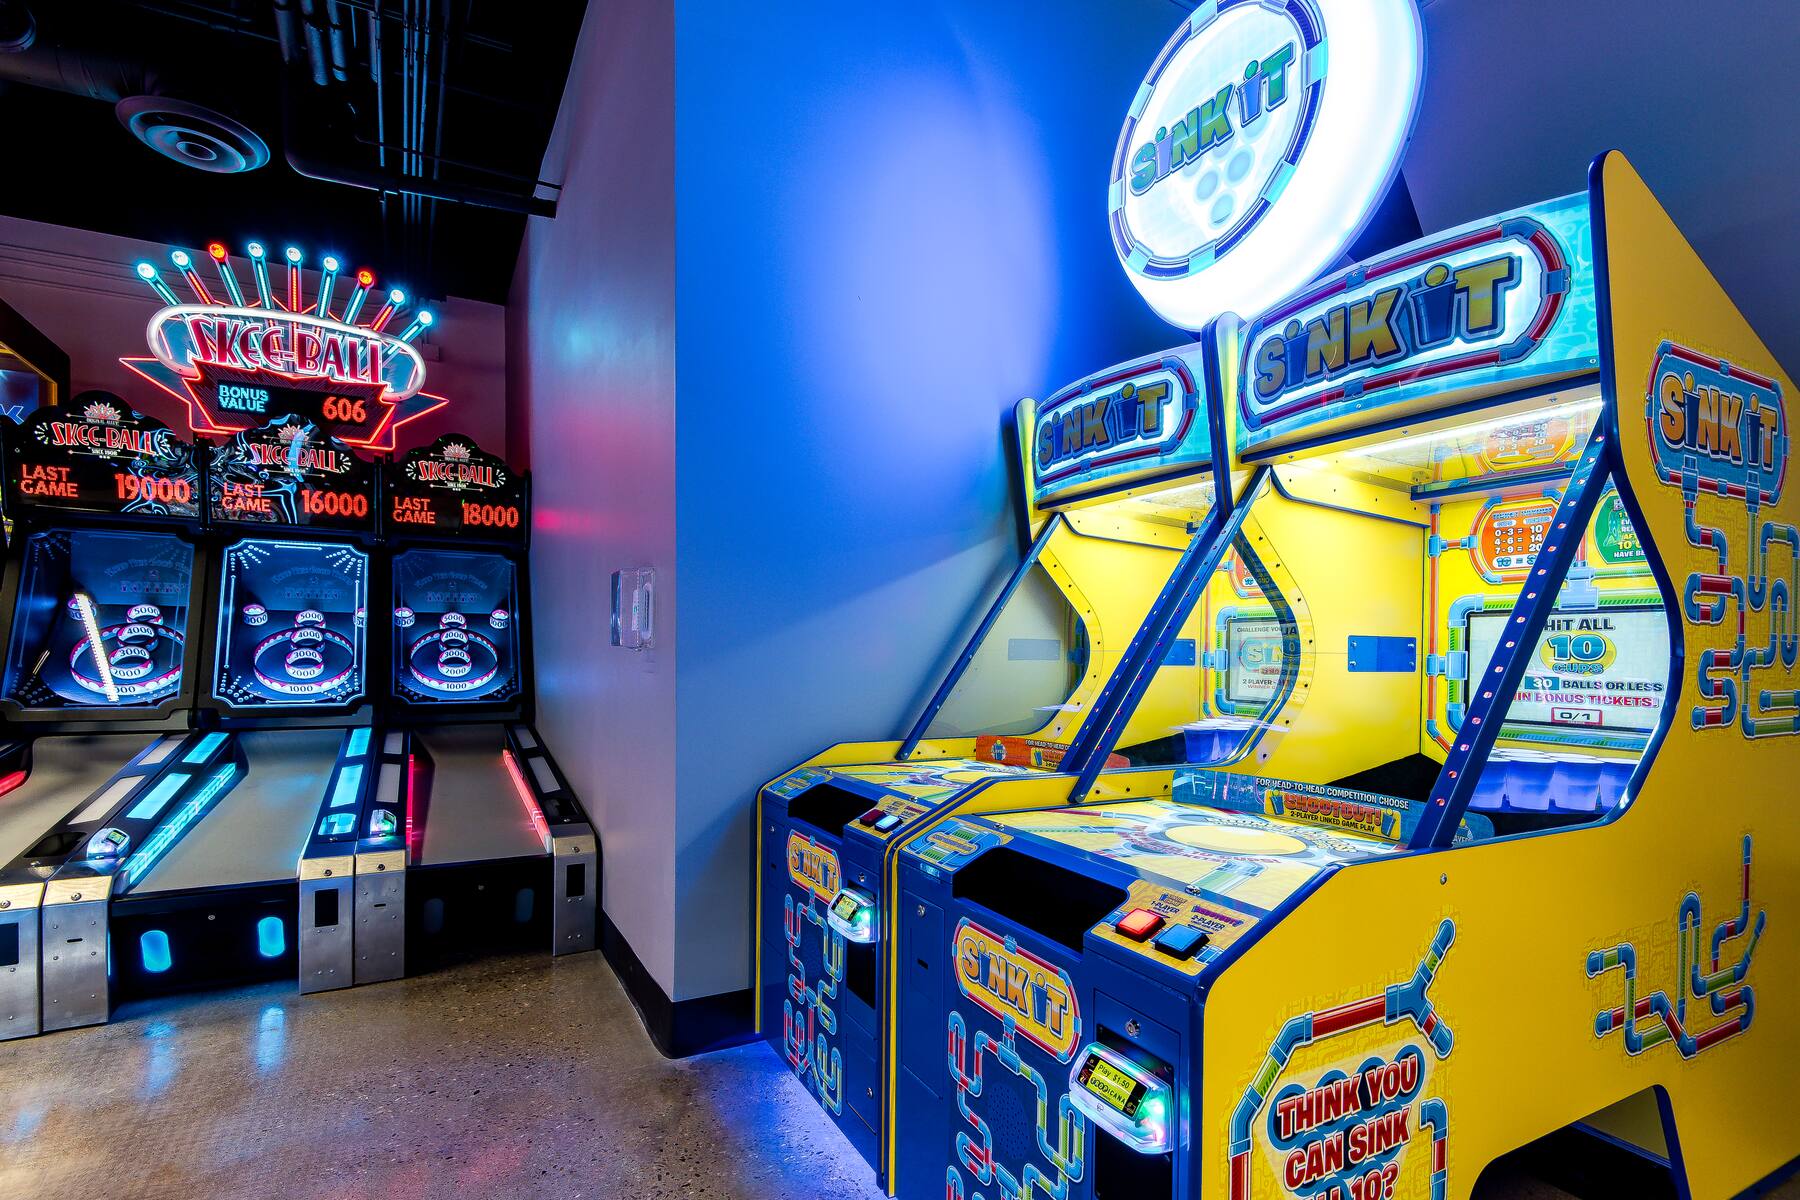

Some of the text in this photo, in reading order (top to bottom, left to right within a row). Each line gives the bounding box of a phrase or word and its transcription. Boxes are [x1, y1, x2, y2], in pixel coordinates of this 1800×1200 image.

[186, 315, 392, 392] SKEE-BALL
[219, 384, 269, 401] BONUS
[219, 396, 266, 413] VALUE
[322, 397, 367, 424] 606
[51, 422, 158, 456] SKEE-BALL
[21, 464, 71, 481] LAST
[20, 480, 80, 498] GAME
[115, 473, 191, 504] 19000
[223, 482, 265, 498] LAST
[222, 497, 271, 512] GAME
[301, 490, 368, 517] 16000
[395, 497, 431, 511] LAST
[393, 510, 436, 524] GAME
[462, 503, 519, 528] 18000
[1530, 525, 1544, 533] 10
[1530, 534, 1543, 543] 14
[134, 607, 159, 616] 5000
[300, 612, 322, 621] 5000
[127, 627, 152, 635] 4000
[1579, 618, 1614, 630] ALL
[120, 648, 146, 657] 3000
[294, 651, 317, 659] 3000
[1547, 634, 1606, 662] 10
[291, 668, 315, 677] 2000
[445, 667, 466, 675] 2000
[1552, 663, 1604, 674] CUPS
[1533, 677, 1663, 692] 30 BALLS OR LESS
[1536, 692, 1584, 703] BONUS
[1560, 712, 1591, 720] 0/1
[1256, 778, 1409, 810] FOR HEAD-TO-HEAD COMPETITION CHOOSE
[1284, 792, 1382, 826] SHOOTOUT!
[1290, 811, 1375, 832] 2-PLAYER LINKED GAME PLAY
[1151, 901, 1180, 914] 1-PLAYER
[1191, 915, 1226, 930] 2-PLAYER
[1098, 1064, 1130, 1089] Play $1.50
[1277, 1053, 1419, 1140] THINK YOU
[1284, 1104, 1412, 1191] CAN SINK
